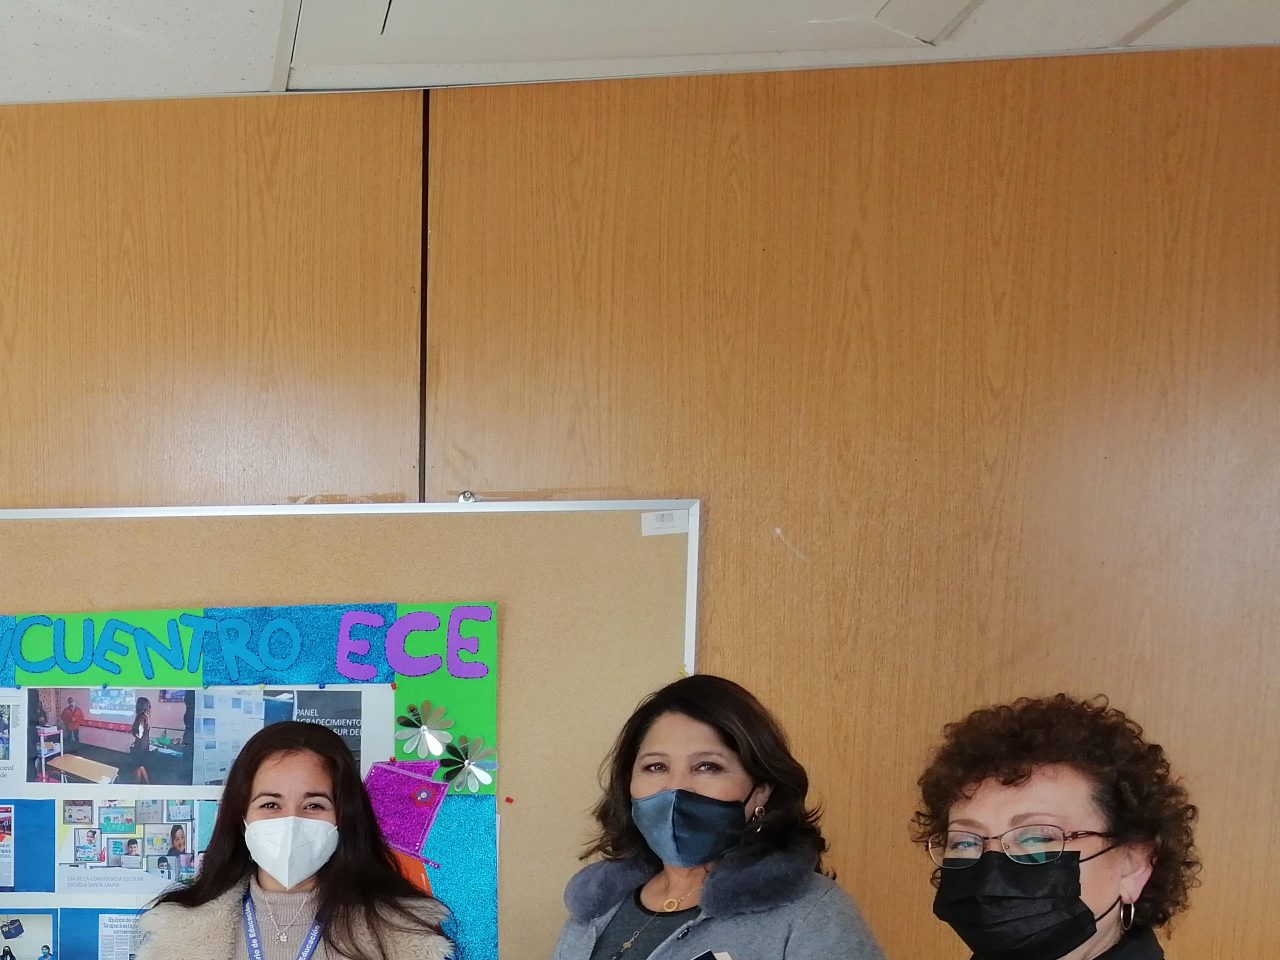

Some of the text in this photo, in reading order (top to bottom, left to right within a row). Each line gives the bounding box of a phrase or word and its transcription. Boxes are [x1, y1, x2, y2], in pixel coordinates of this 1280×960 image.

[336, 605, 493, 681] ECE
[296, 709, 319, 717] PANEL
[333, 728, 348, 736] SUR
[251, 939, 259, 948] de
